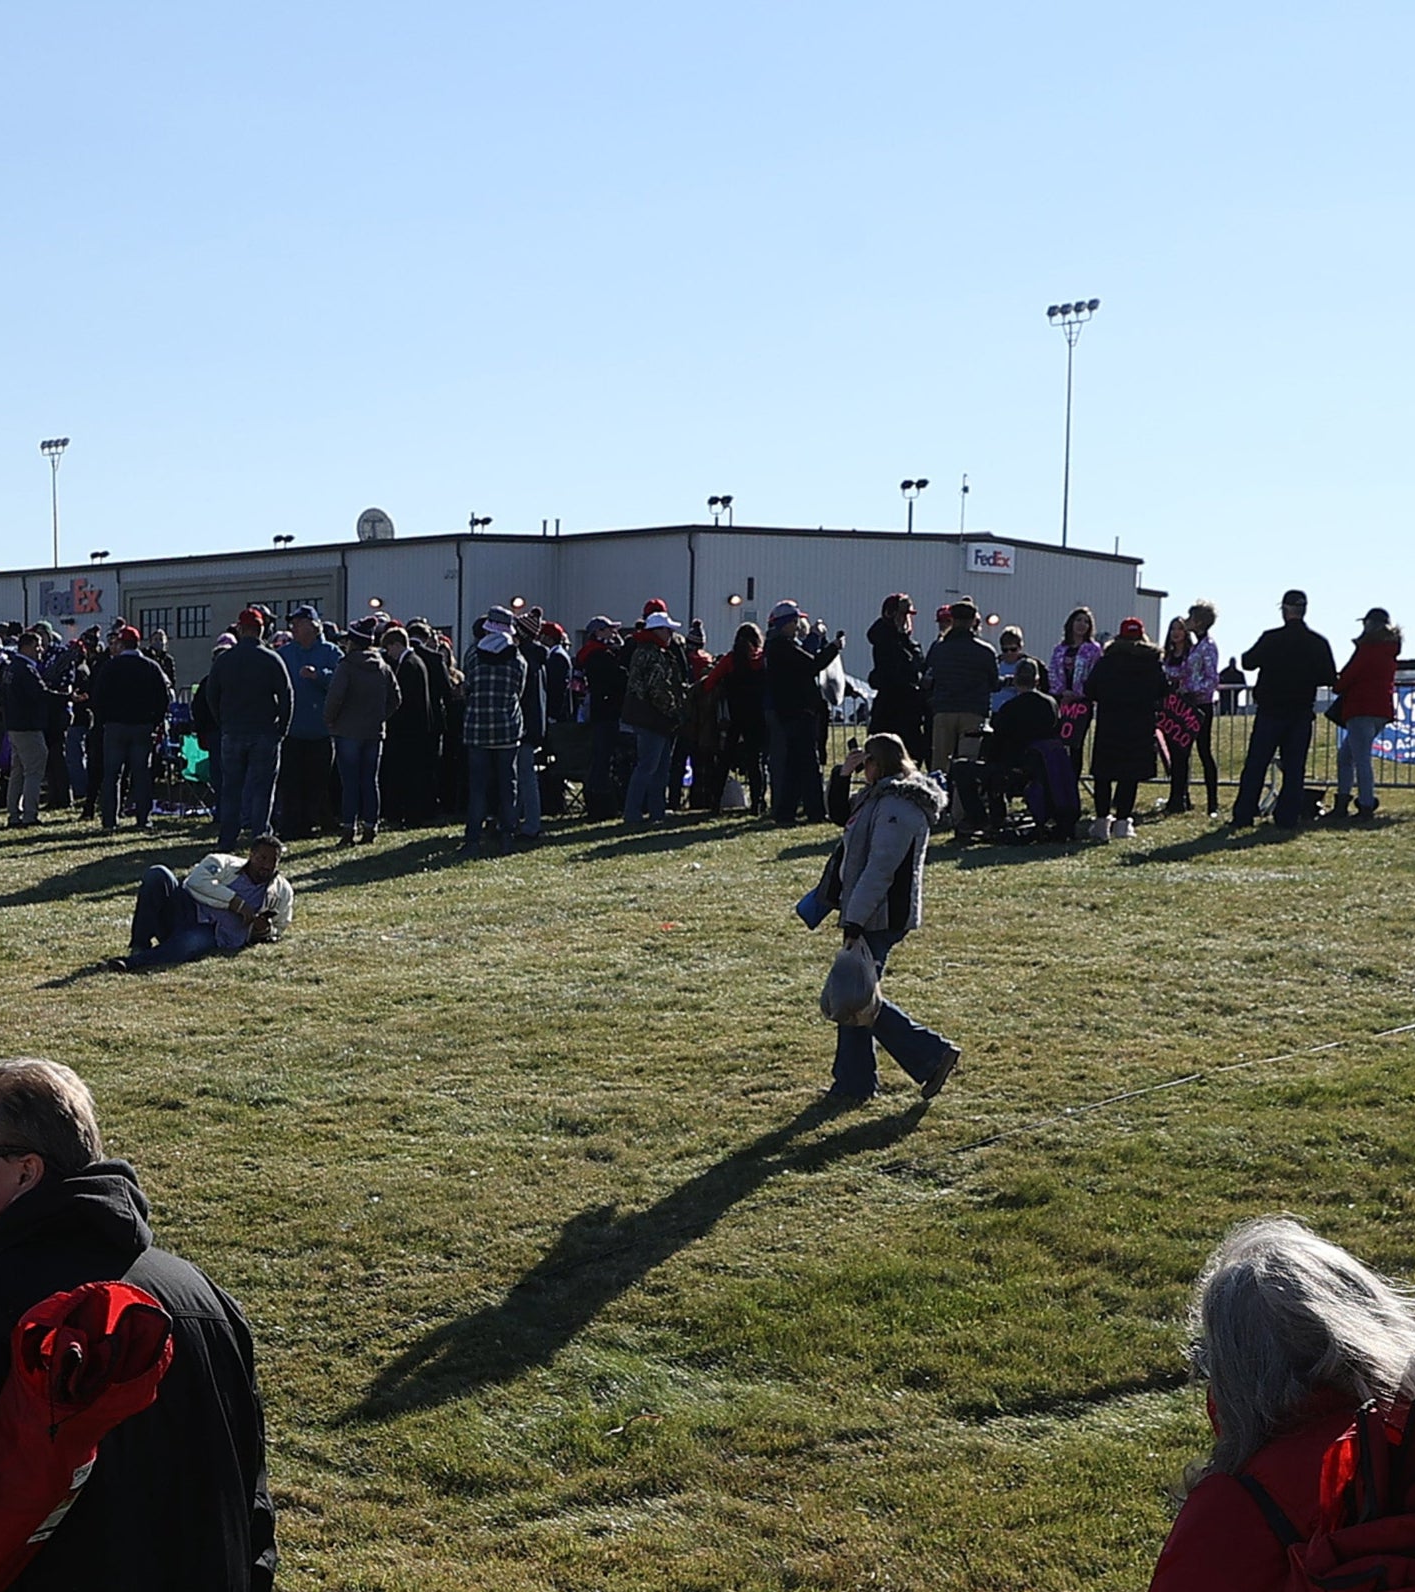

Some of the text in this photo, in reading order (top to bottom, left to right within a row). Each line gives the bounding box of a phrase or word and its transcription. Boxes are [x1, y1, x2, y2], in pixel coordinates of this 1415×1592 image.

[974, 549, 1011, 568] FedEx
[39, 577, 103, 616] FedEx
[1156, 711, 1191, 747] 2020
